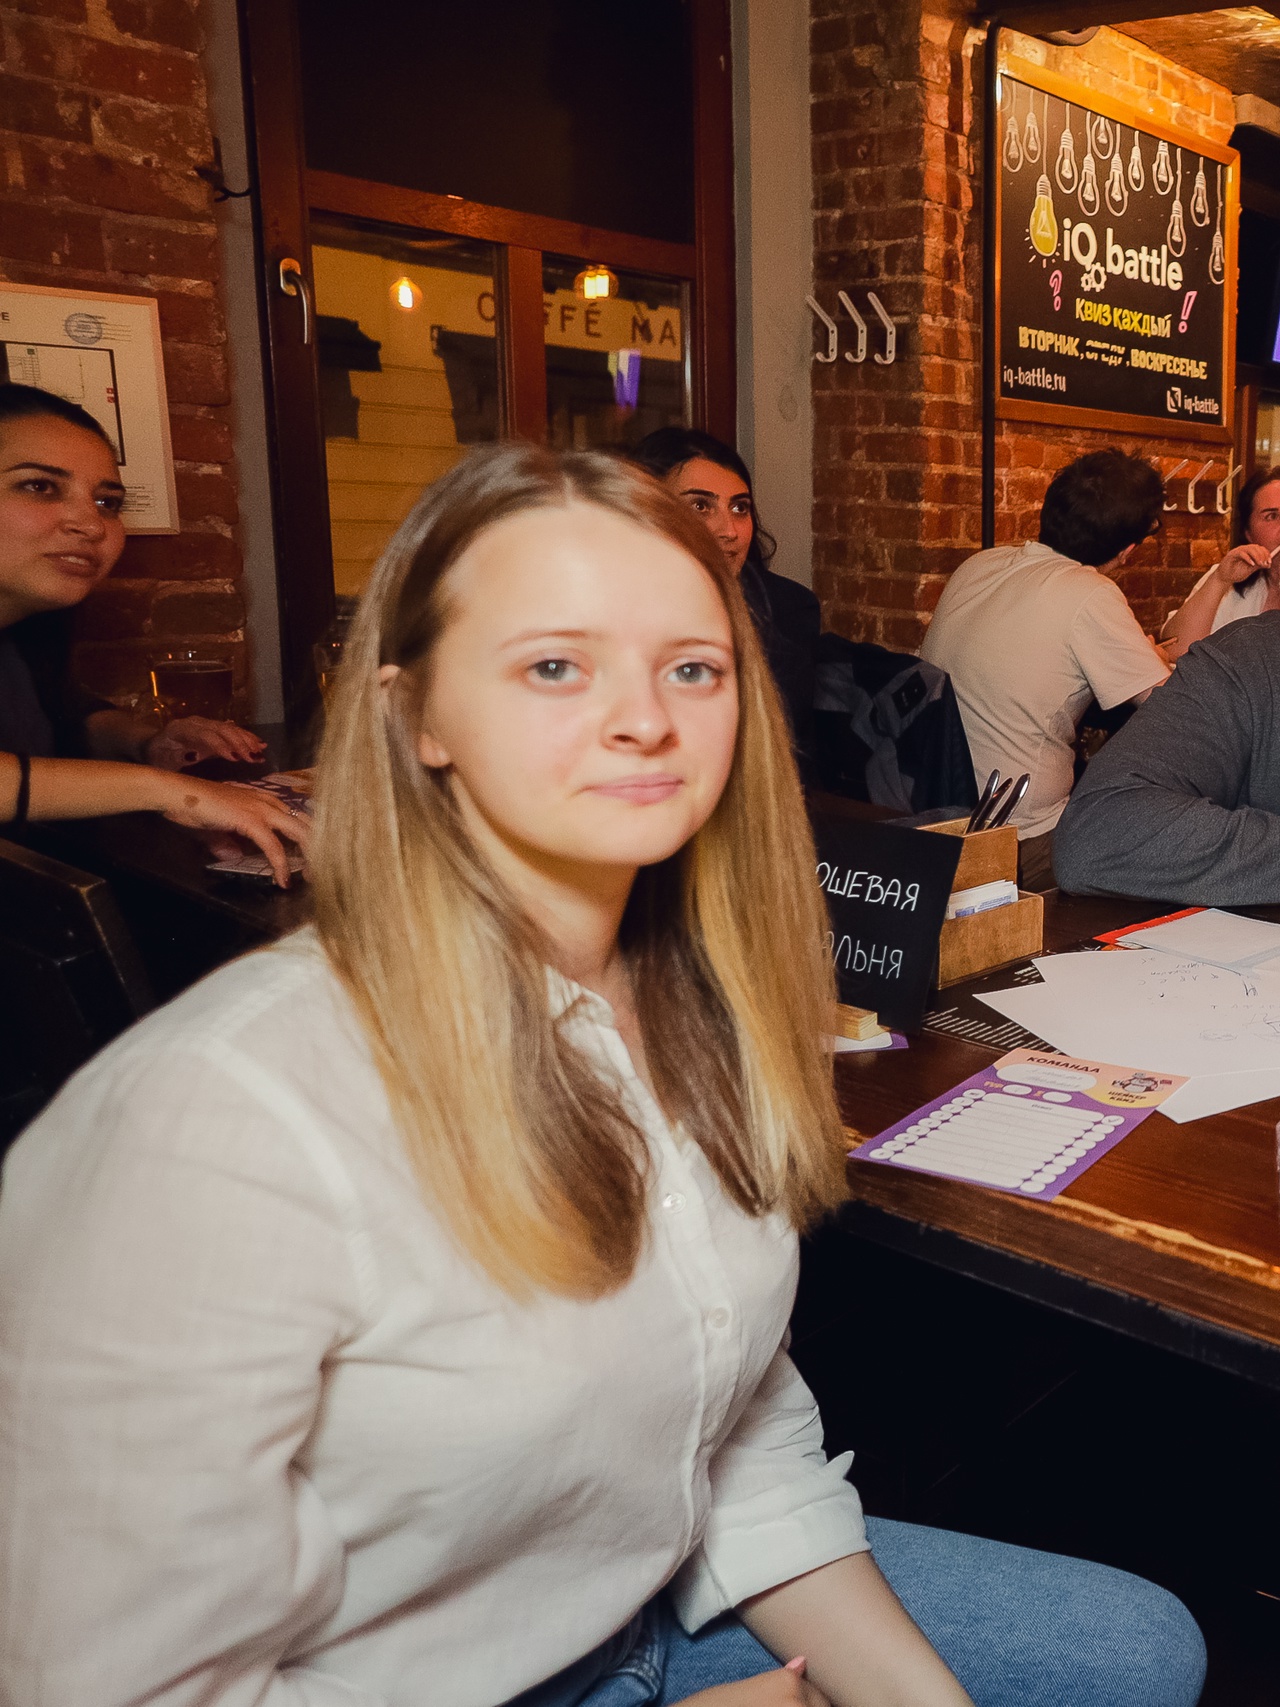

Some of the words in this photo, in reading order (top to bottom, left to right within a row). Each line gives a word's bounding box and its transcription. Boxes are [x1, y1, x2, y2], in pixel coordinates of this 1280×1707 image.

[1063, 217, 1098, 272] iQ
[1106, 227, 1183, 291] battle
[1018, 326, 1084, 360] ВТОРНИК,
[1130, 348, 1208, 380] ВОСКРЕСЕНЬЕ
[1003, 365, 1067, 393] iq-battle.ru
[1183, 395, 1219, 416] iq-battle
[1026, 1056, 1101, 1074] КОМАНДА
